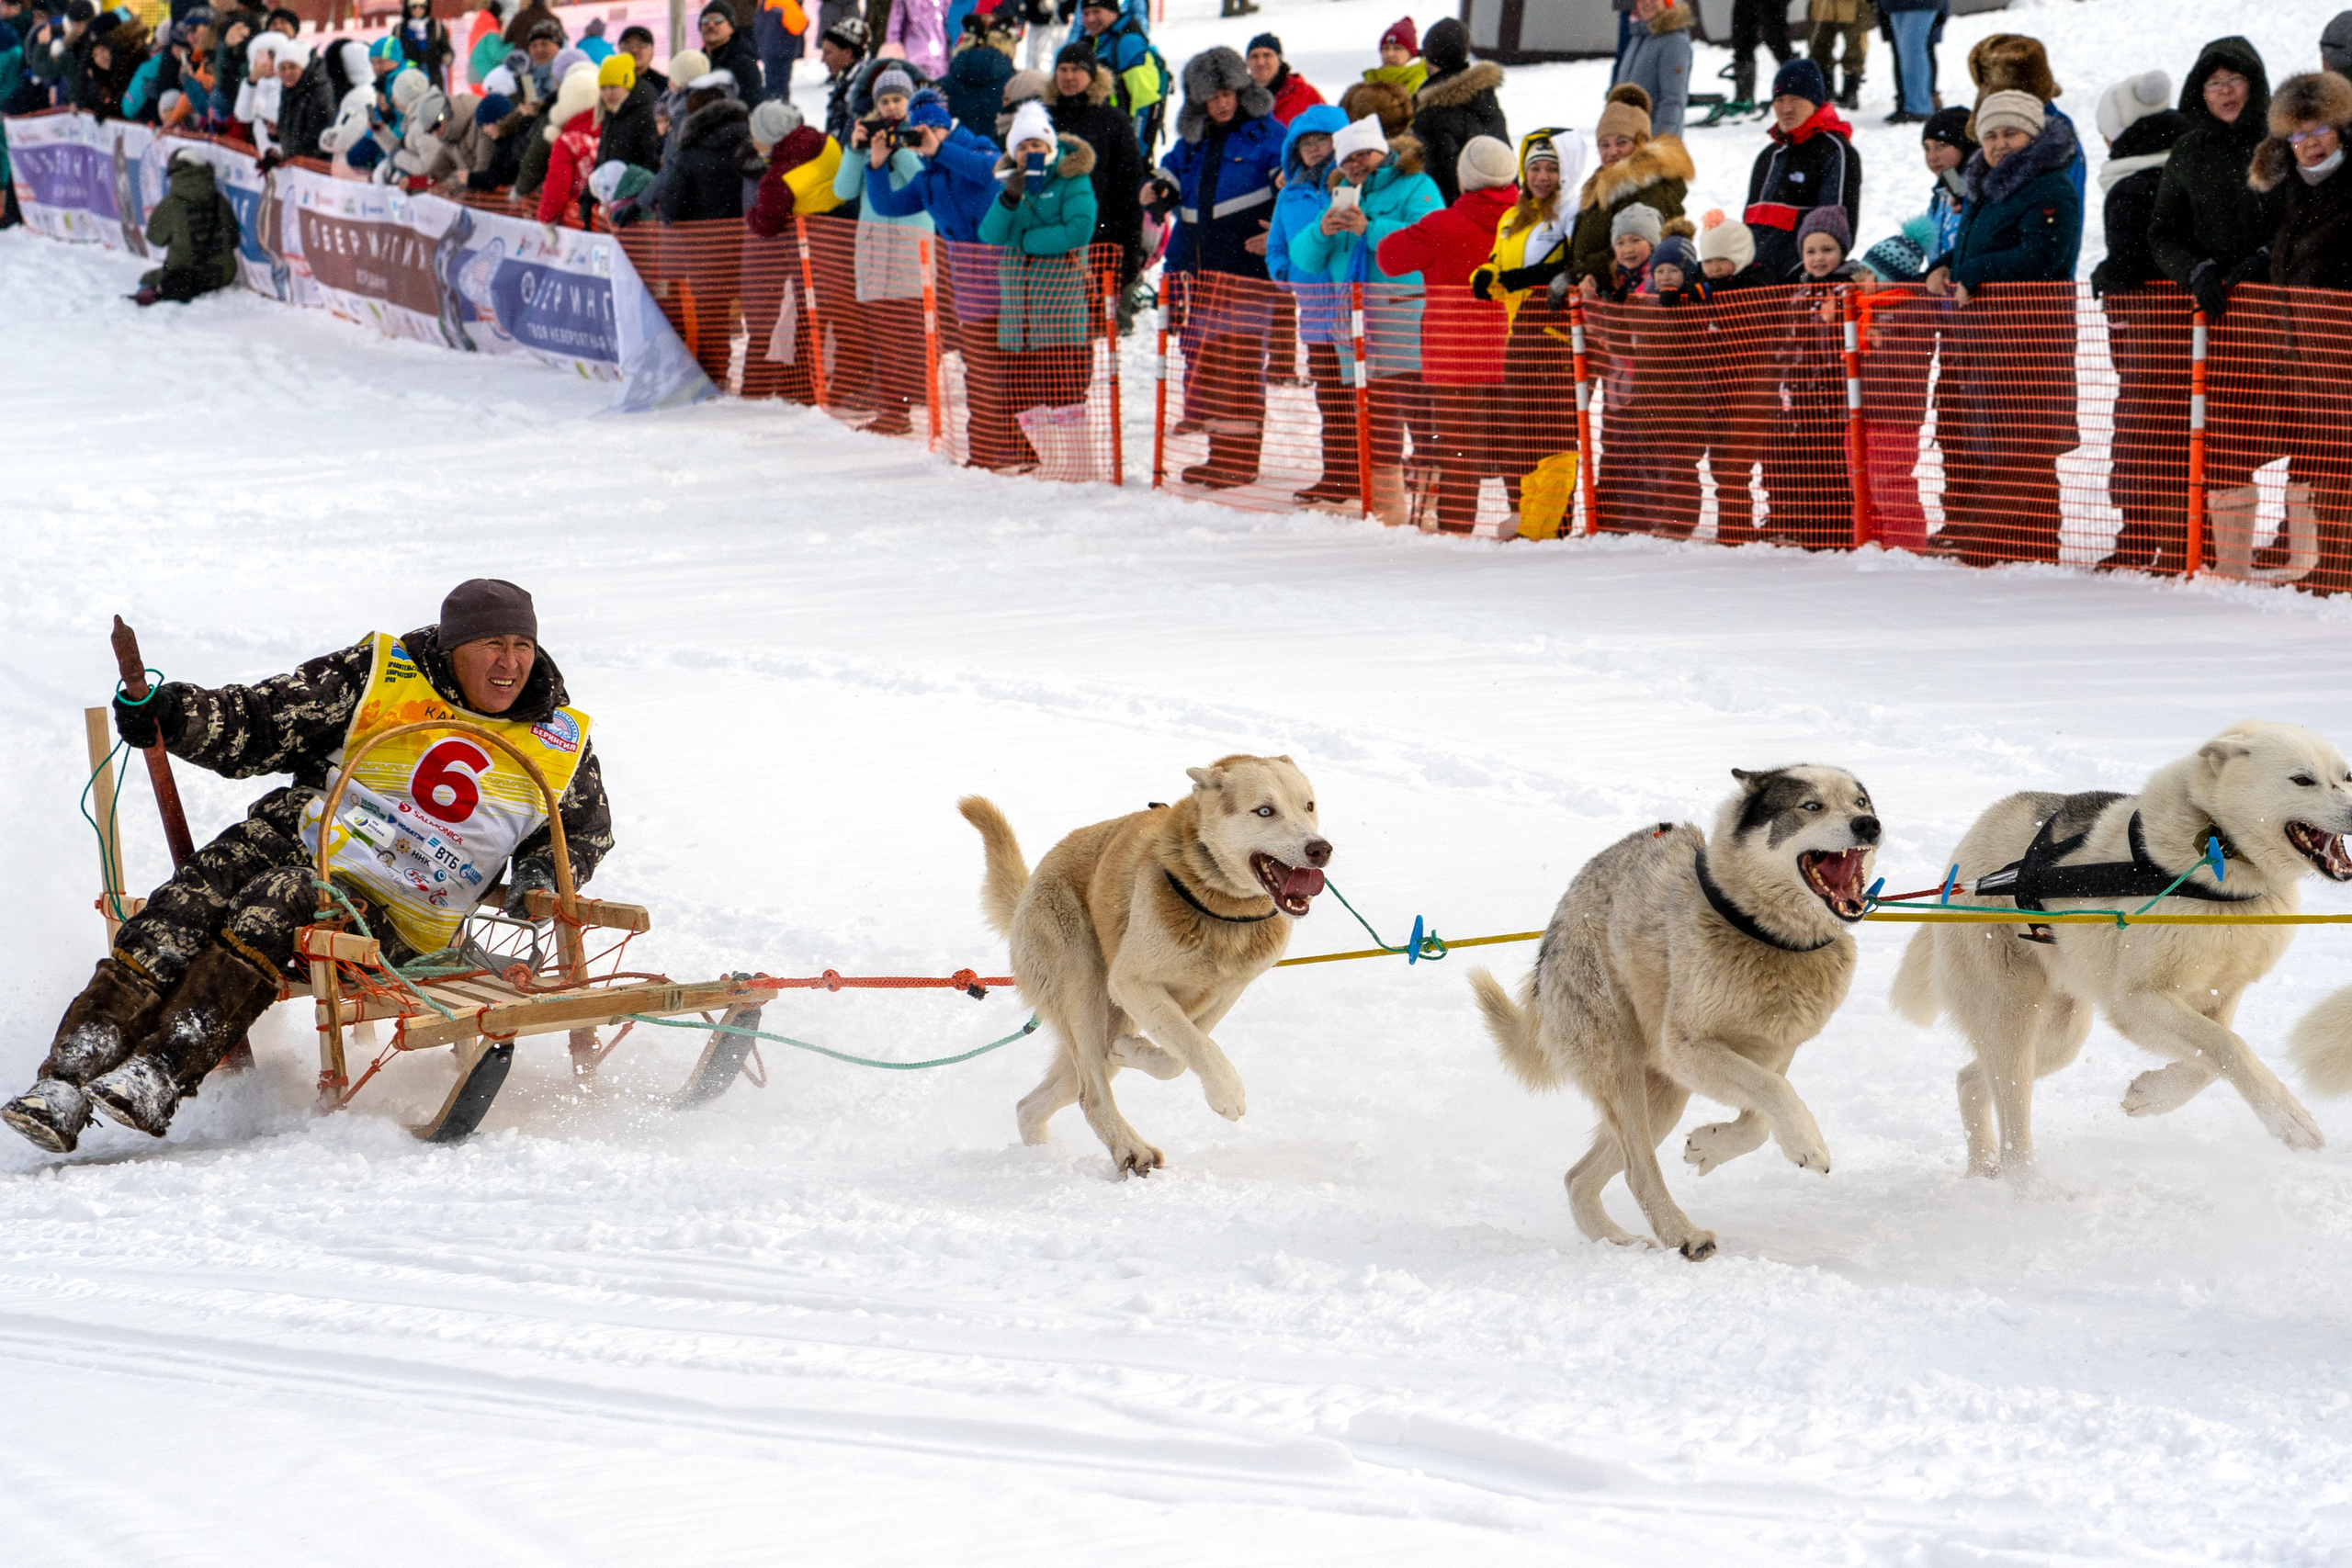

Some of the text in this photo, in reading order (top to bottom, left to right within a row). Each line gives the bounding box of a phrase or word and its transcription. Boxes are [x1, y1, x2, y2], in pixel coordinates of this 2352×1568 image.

[533, 727, 577, 751] БЕРИНГИЯ
[411, 739, 493, 824] 6
[398, 821, 426, 842] НОВАТЭК
[413, 810, 464, 845] SALMONICA
[411, 850, 431, 867] ННК
[435, 846, 460, 870] ВТБ
